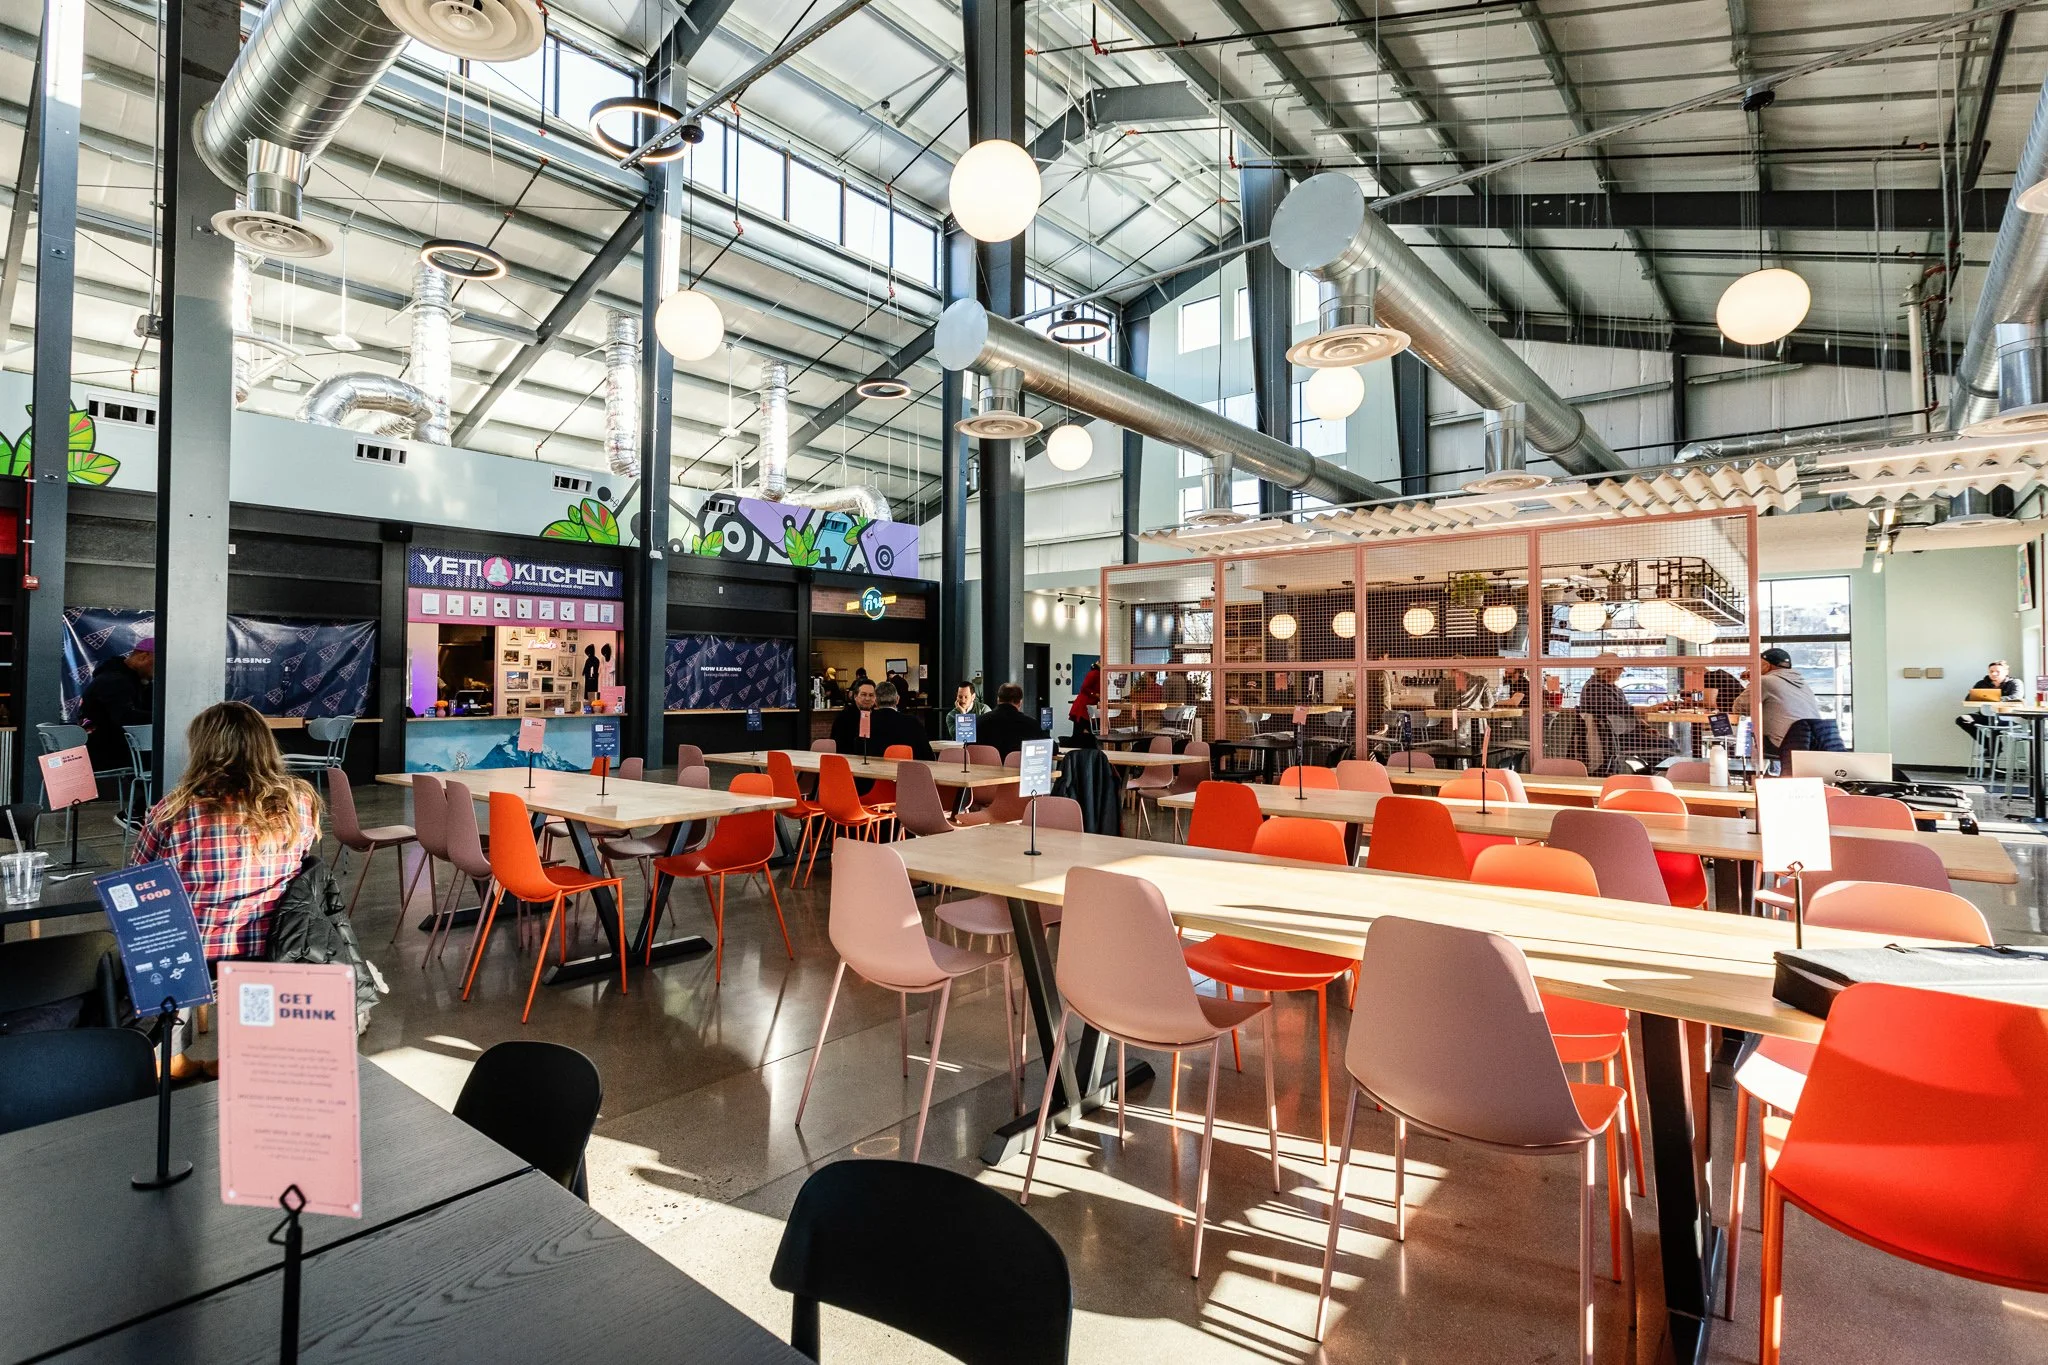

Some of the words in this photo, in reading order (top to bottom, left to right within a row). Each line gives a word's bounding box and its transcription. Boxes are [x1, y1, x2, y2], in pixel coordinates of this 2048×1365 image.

[420, 555, 481, 576] YETI
[514, 563, 614, 587] KITCHEN
[135, 880, 157, 891] GET
[140, 888, 172, 902] FOOD
[279, 993, 312, 1005] GET
[279, 1008, 336, 1020] DRINK
